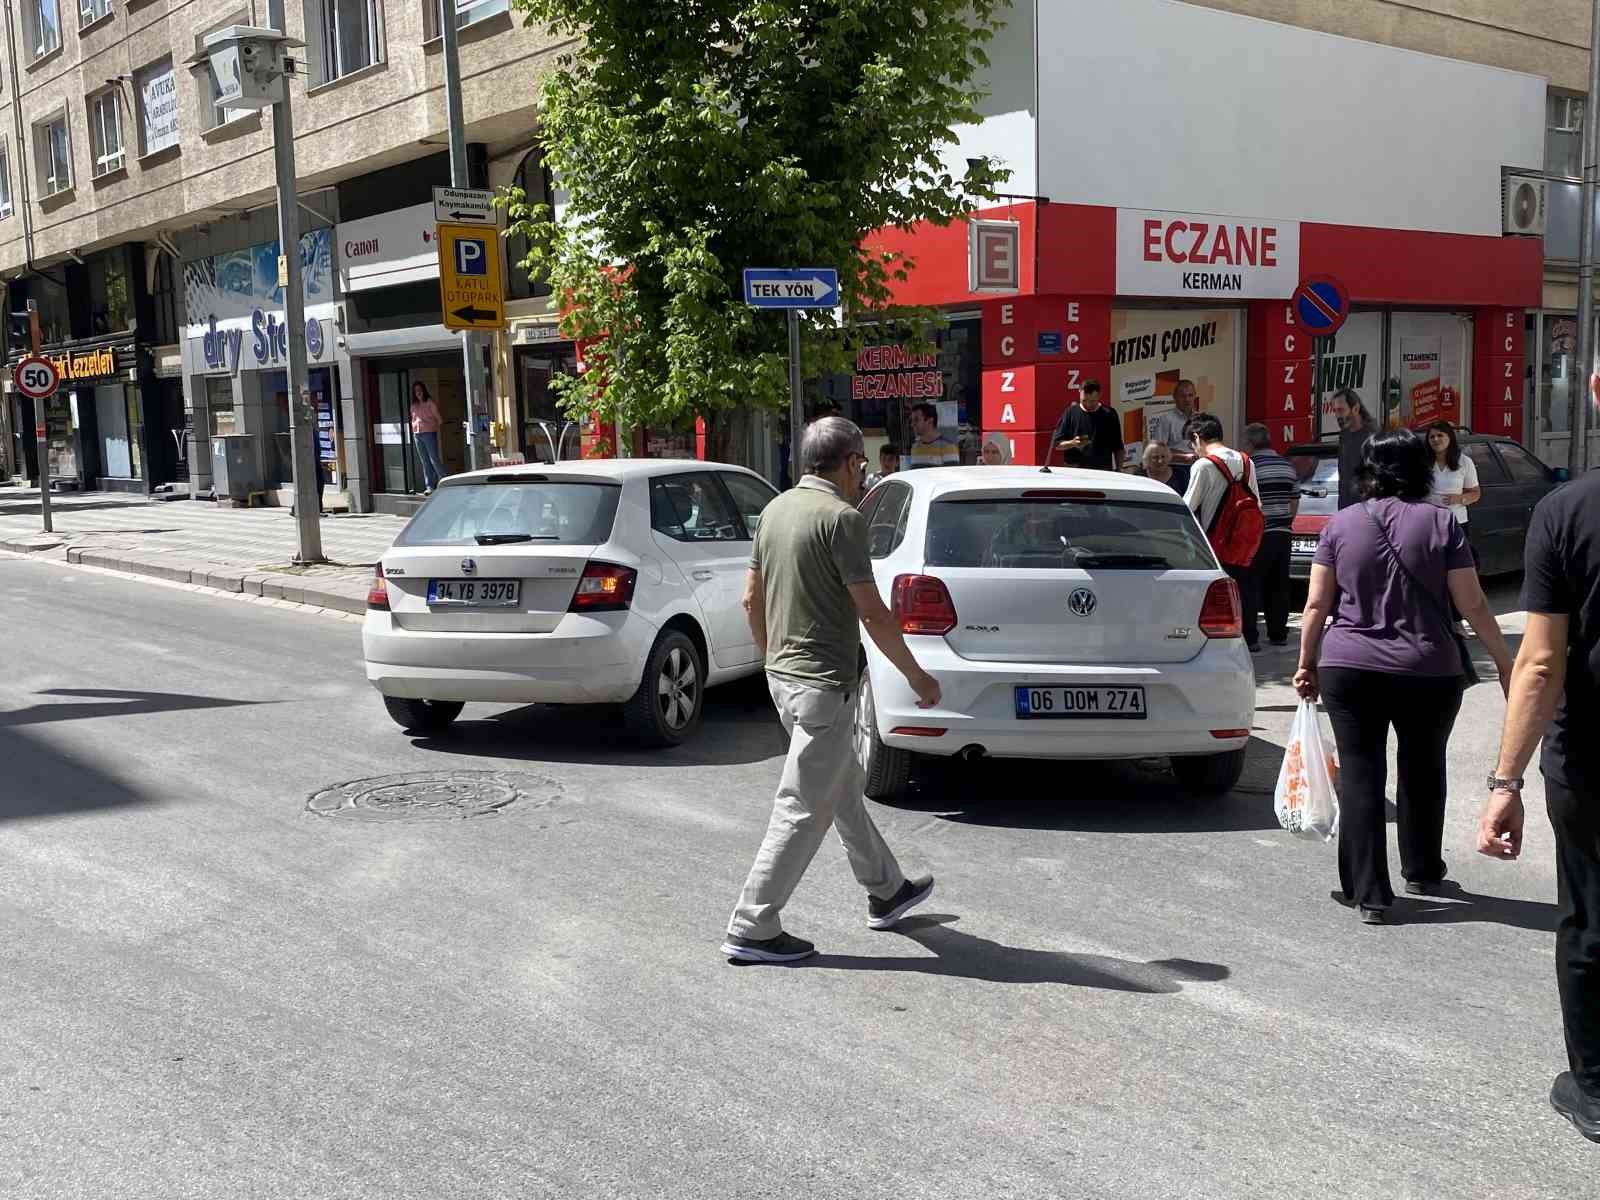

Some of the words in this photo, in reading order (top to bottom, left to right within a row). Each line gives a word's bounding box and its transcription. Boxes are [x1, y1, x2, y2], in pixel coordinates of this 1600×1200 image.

[344, 238, 379, 258] Canon
[1143, 219, 1277, 267] ECZANE
[458, 240, 481, 272] P
[752, 284, 780, 296] TEK
[785, 282, 814, 297] YÖN
[1182, 272, 1242, 291] KERMAN
[447, 290, 500, 304] OTOPARK
[203, 313, 242, 378] dry
[252, 306, 323, 365] Stoe
[67, 346, 115, 379] Lezzetleri
[25, 370, 49, 387] 50
[852, 371, 944, 400] ECZANESİ
[437, 582, 453, 600] 34
[481, 583, 514, 600] 3978
[1031, 691, 1053, 711] 06
[1064, 691, 1100, 711] DOM
[1106, 691, 1140, 711] 274
